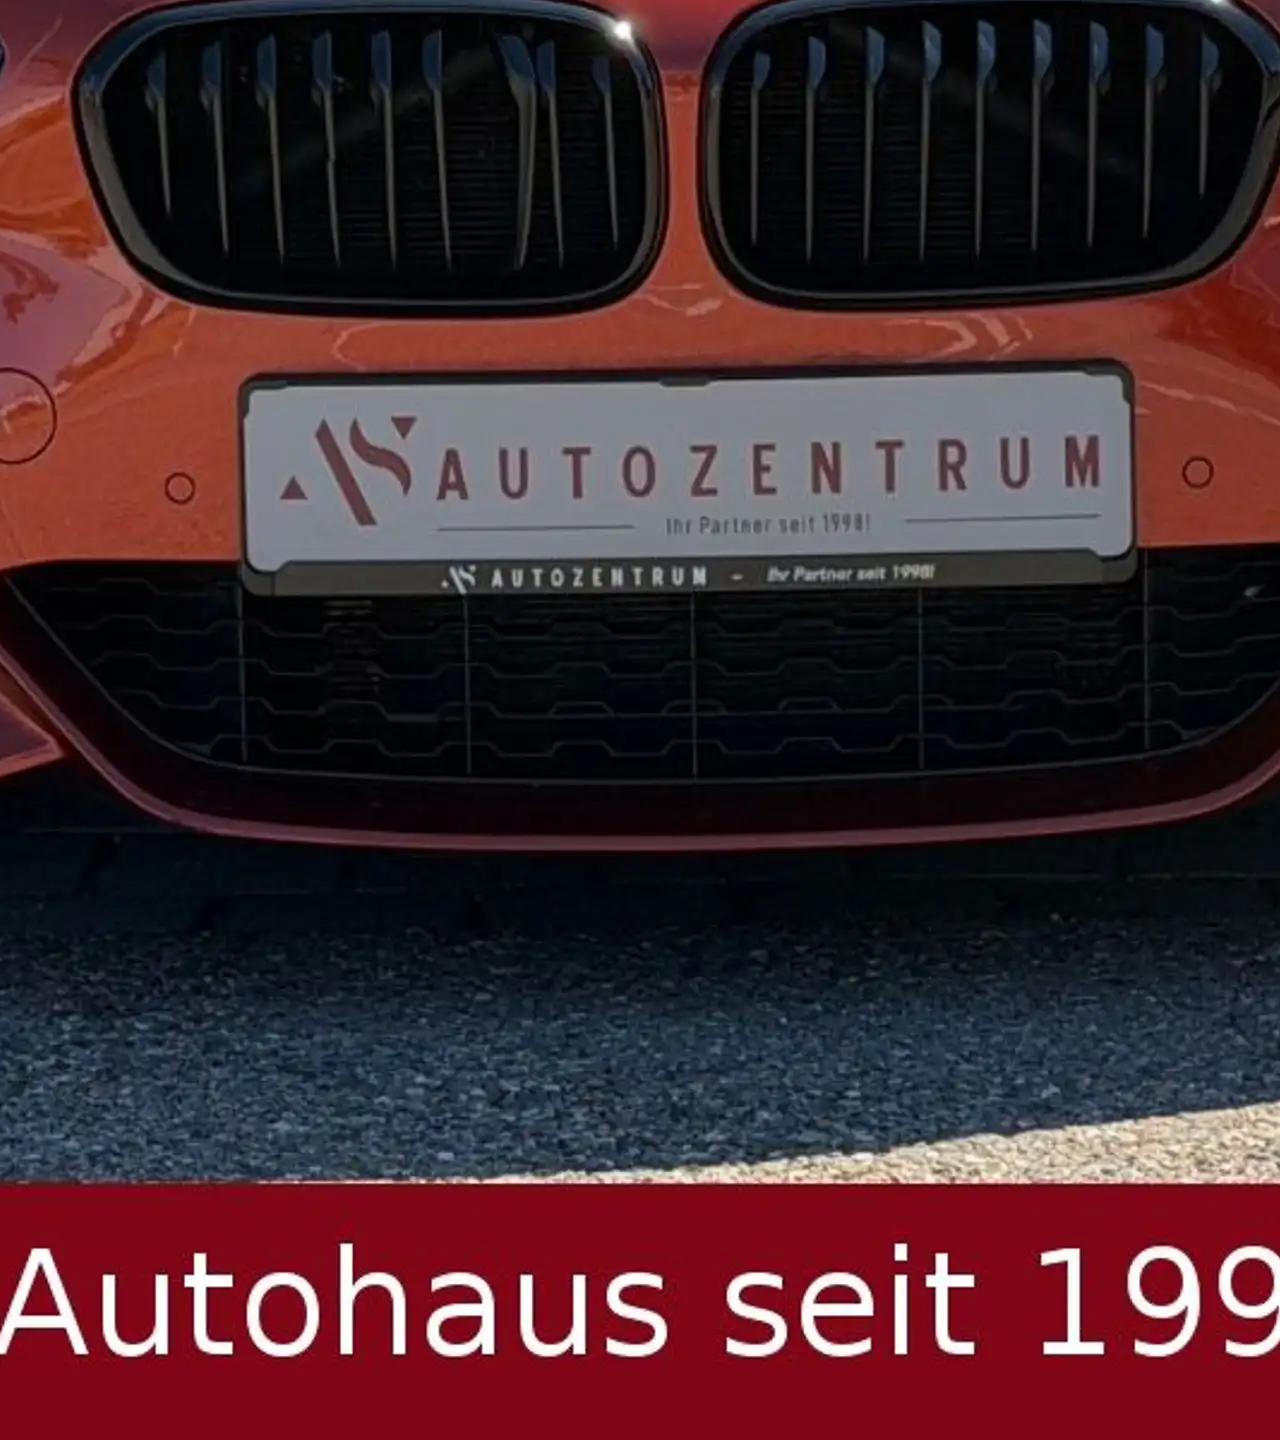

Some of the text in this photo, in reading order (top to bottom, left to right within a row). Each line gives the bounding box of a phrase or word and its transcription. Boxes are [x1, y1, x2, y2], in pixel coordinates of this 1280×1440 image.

[436, 435, 1101, 501] AUTOZENTRUM
[665, 517, 693, 536] Ihr
[699, 515, 772, 536] Partner
[778, 515, 815, 534] seit
[490, 565, 709, 589] AUTOZENTRUM
[766, 565, 791, 582] Ihr
[793, 563, 852, 582] Partner
[856, 564, 887, 581] seit
